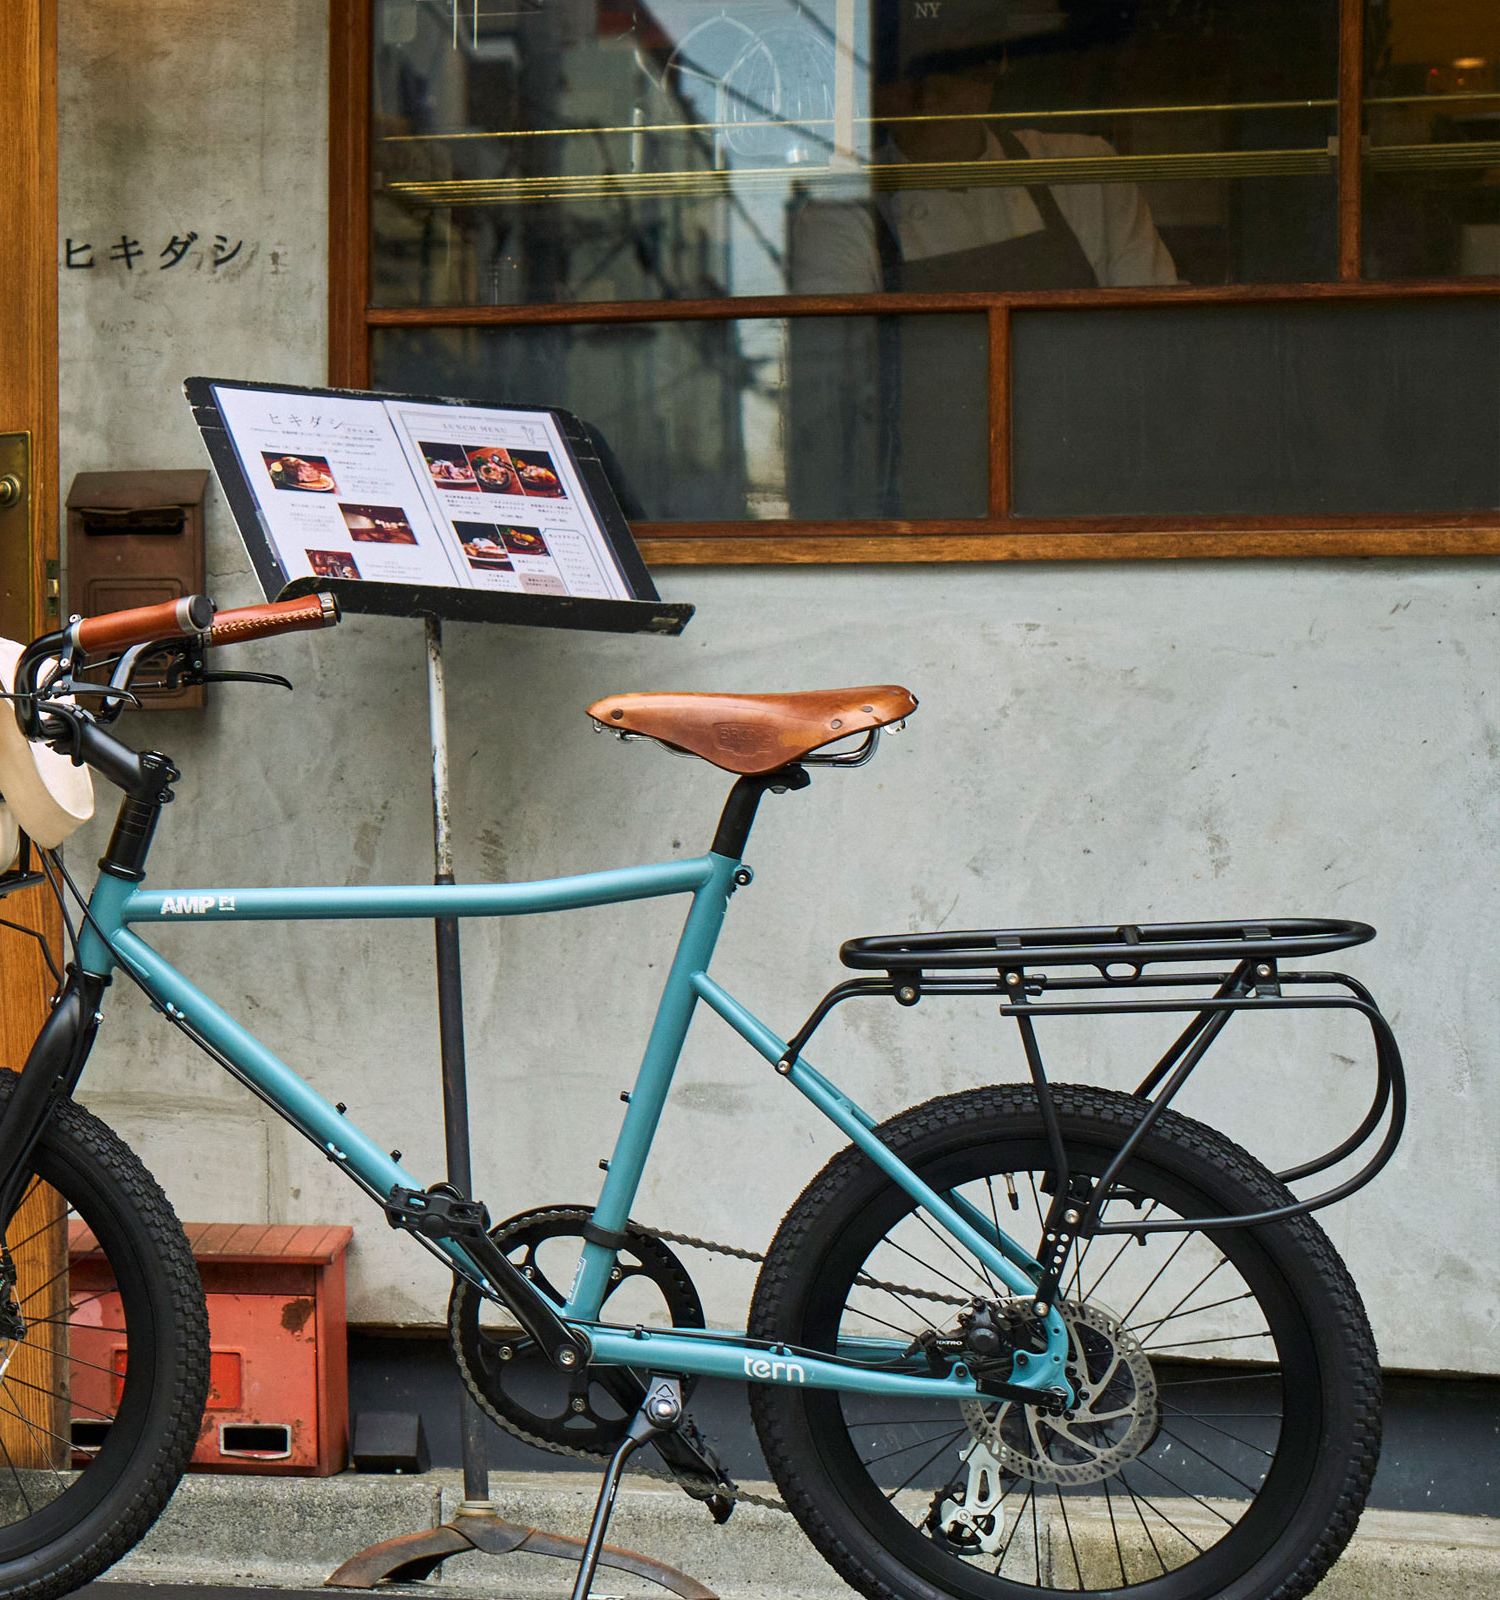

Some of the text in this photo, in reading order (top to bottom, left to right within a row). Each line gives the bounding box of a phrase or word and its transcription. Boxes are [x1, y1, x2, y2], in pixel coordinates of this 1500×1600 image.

[65, 231, 243, 271] ヒキダシ
[160, 896, 216, 914] AMP
[744, 1355, 805, 1383] tern
